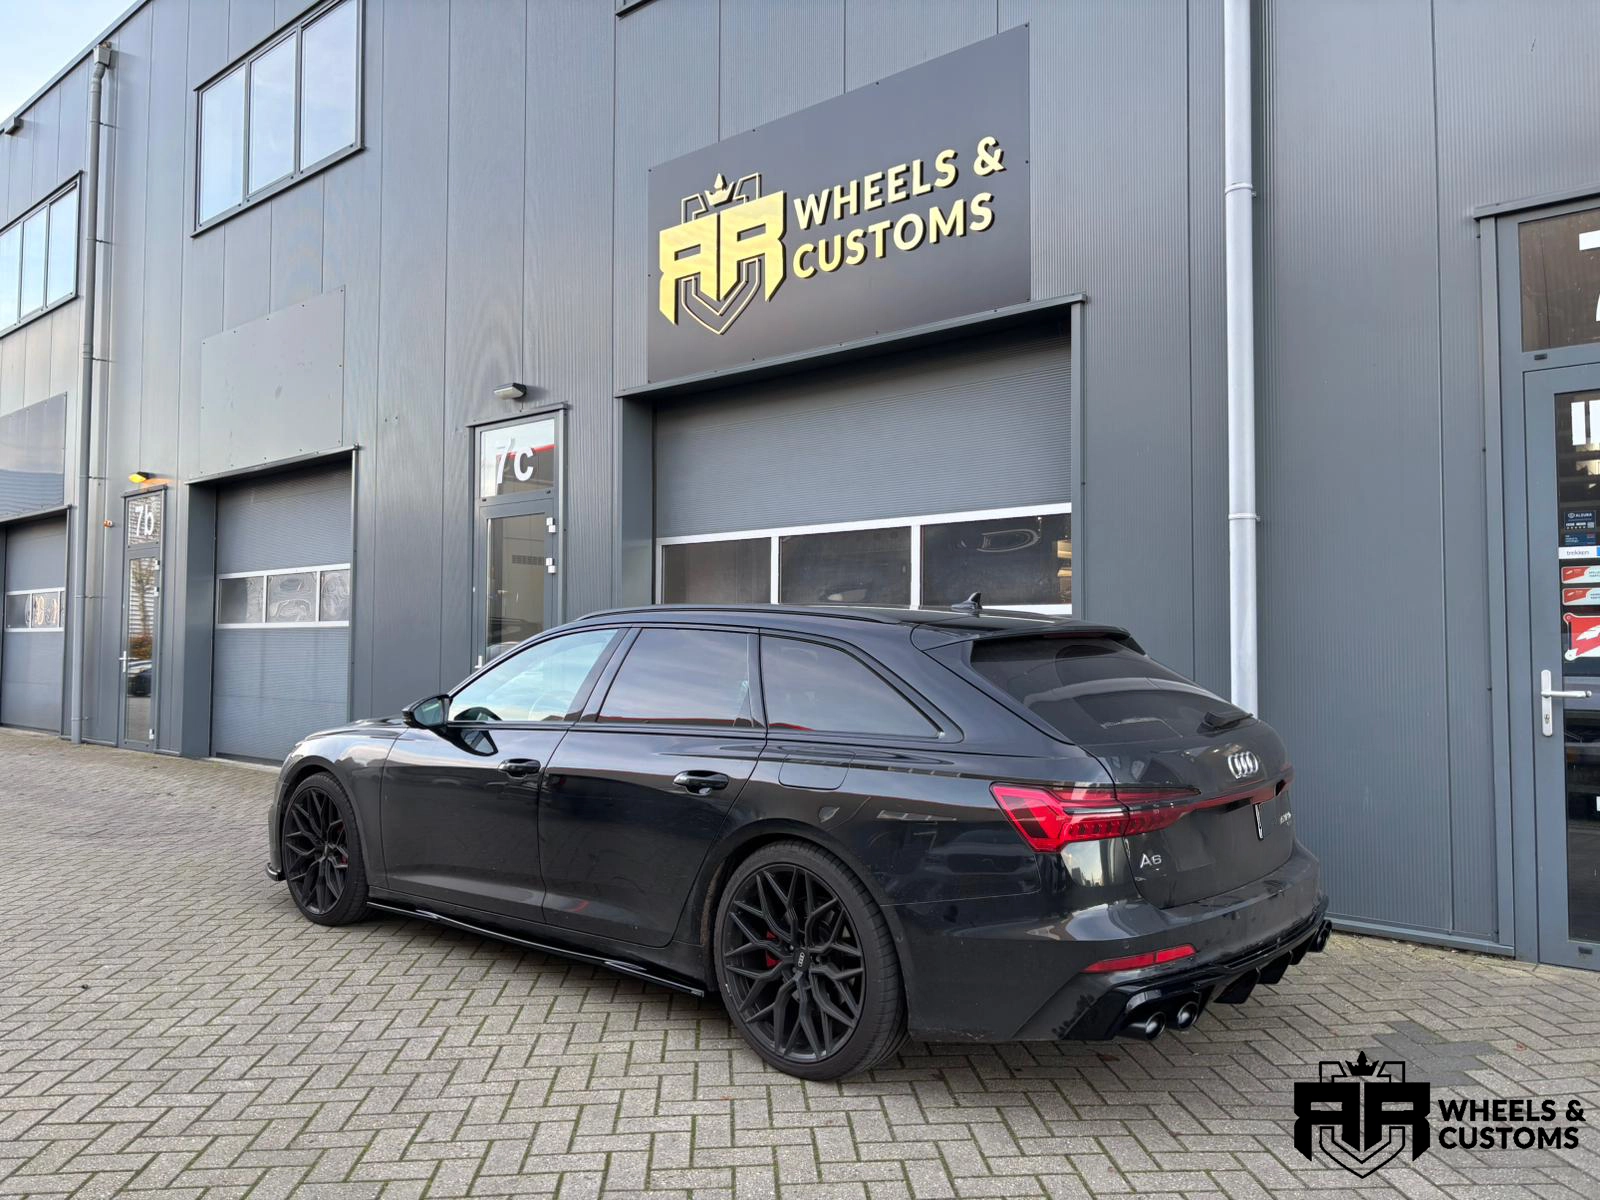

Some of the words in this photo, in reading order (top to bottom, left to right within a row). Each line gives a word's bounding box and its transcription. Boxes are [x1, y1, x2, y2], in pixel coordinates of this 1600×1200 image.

[793, 149, 958, 231] WHEELS
[973, 136, 1006, 177] &
[793, 192, 995, 279] CUSTOMS
[135, 504, 154, 536] 7b
[1140, 853, 1162, 868] A6
